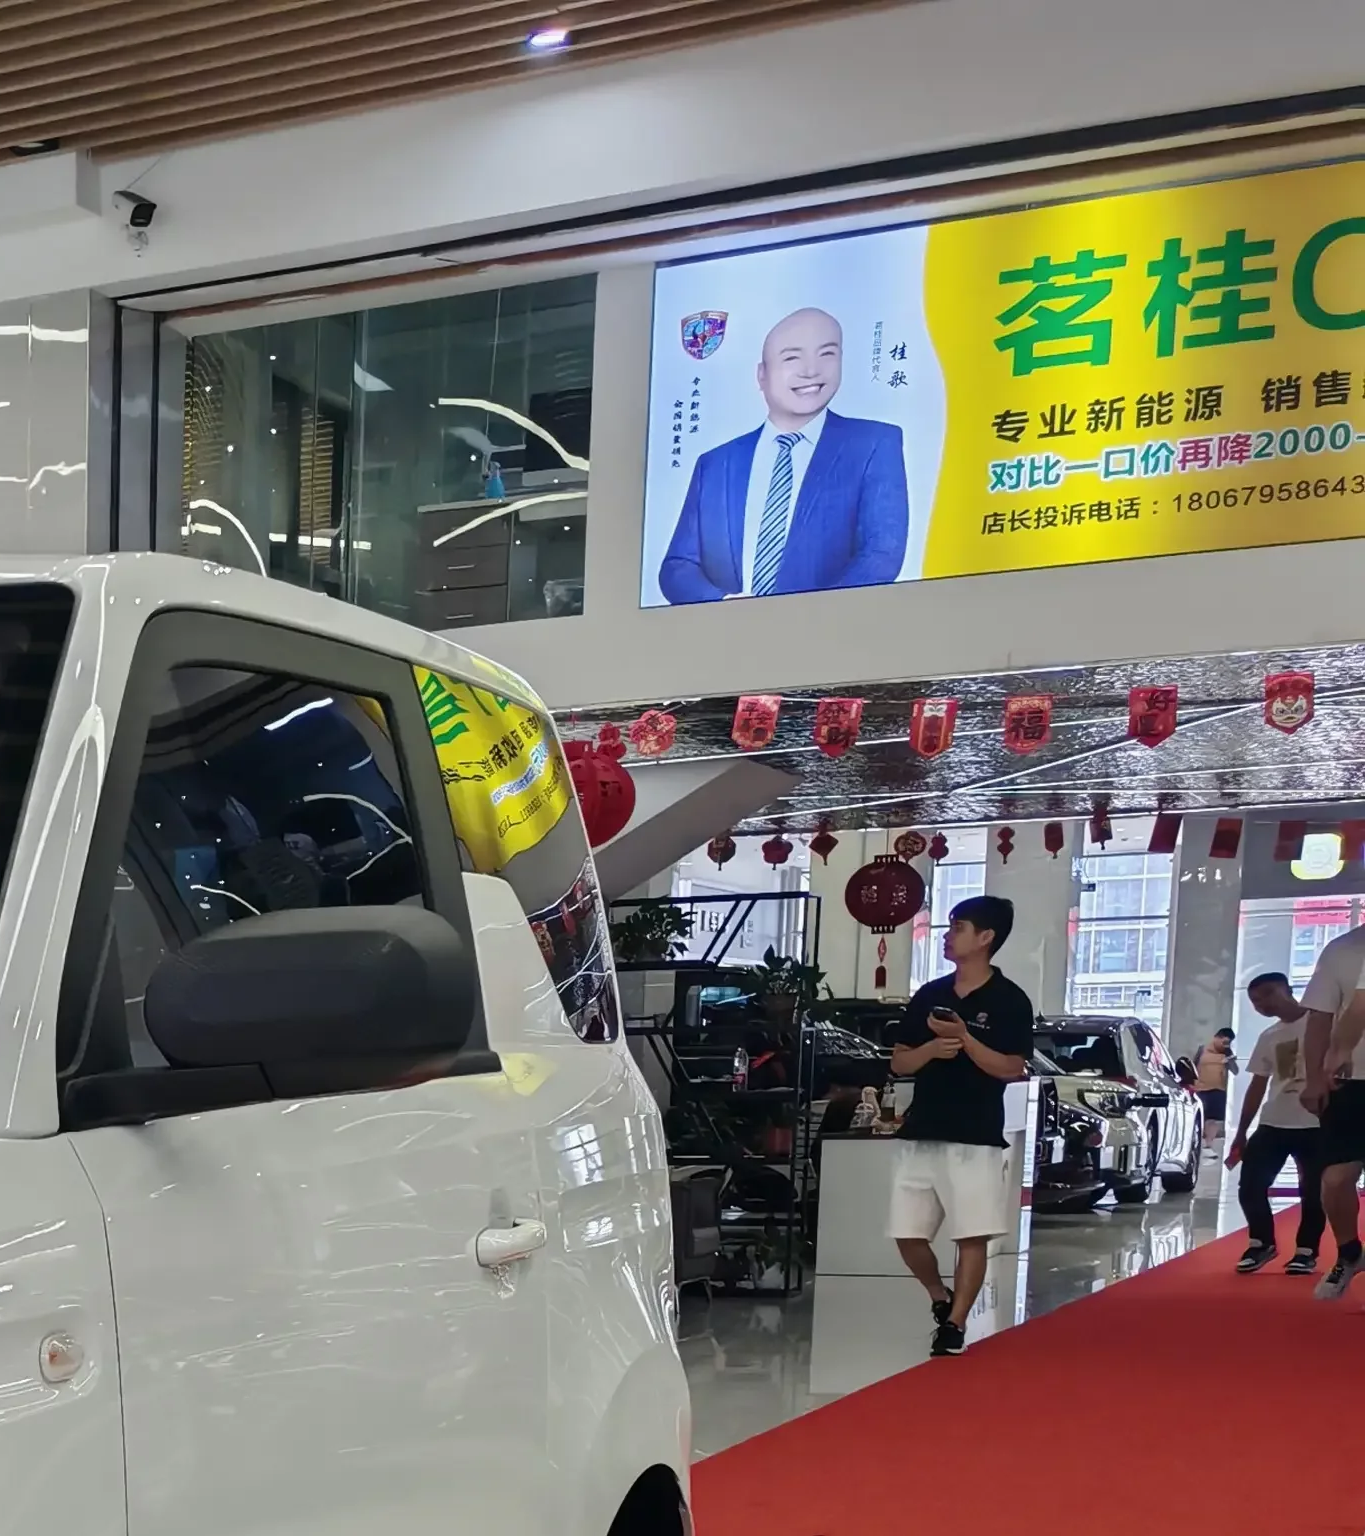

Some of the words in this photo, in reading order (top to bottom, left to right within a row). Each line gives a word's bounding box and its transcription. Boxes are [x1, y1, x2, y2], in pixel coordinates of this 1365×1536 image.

[991, 384, 1225, 443] 专业新能源
[1260, 369, 1365, 415] 销售
[1009, 708, 1045, 741] 福
